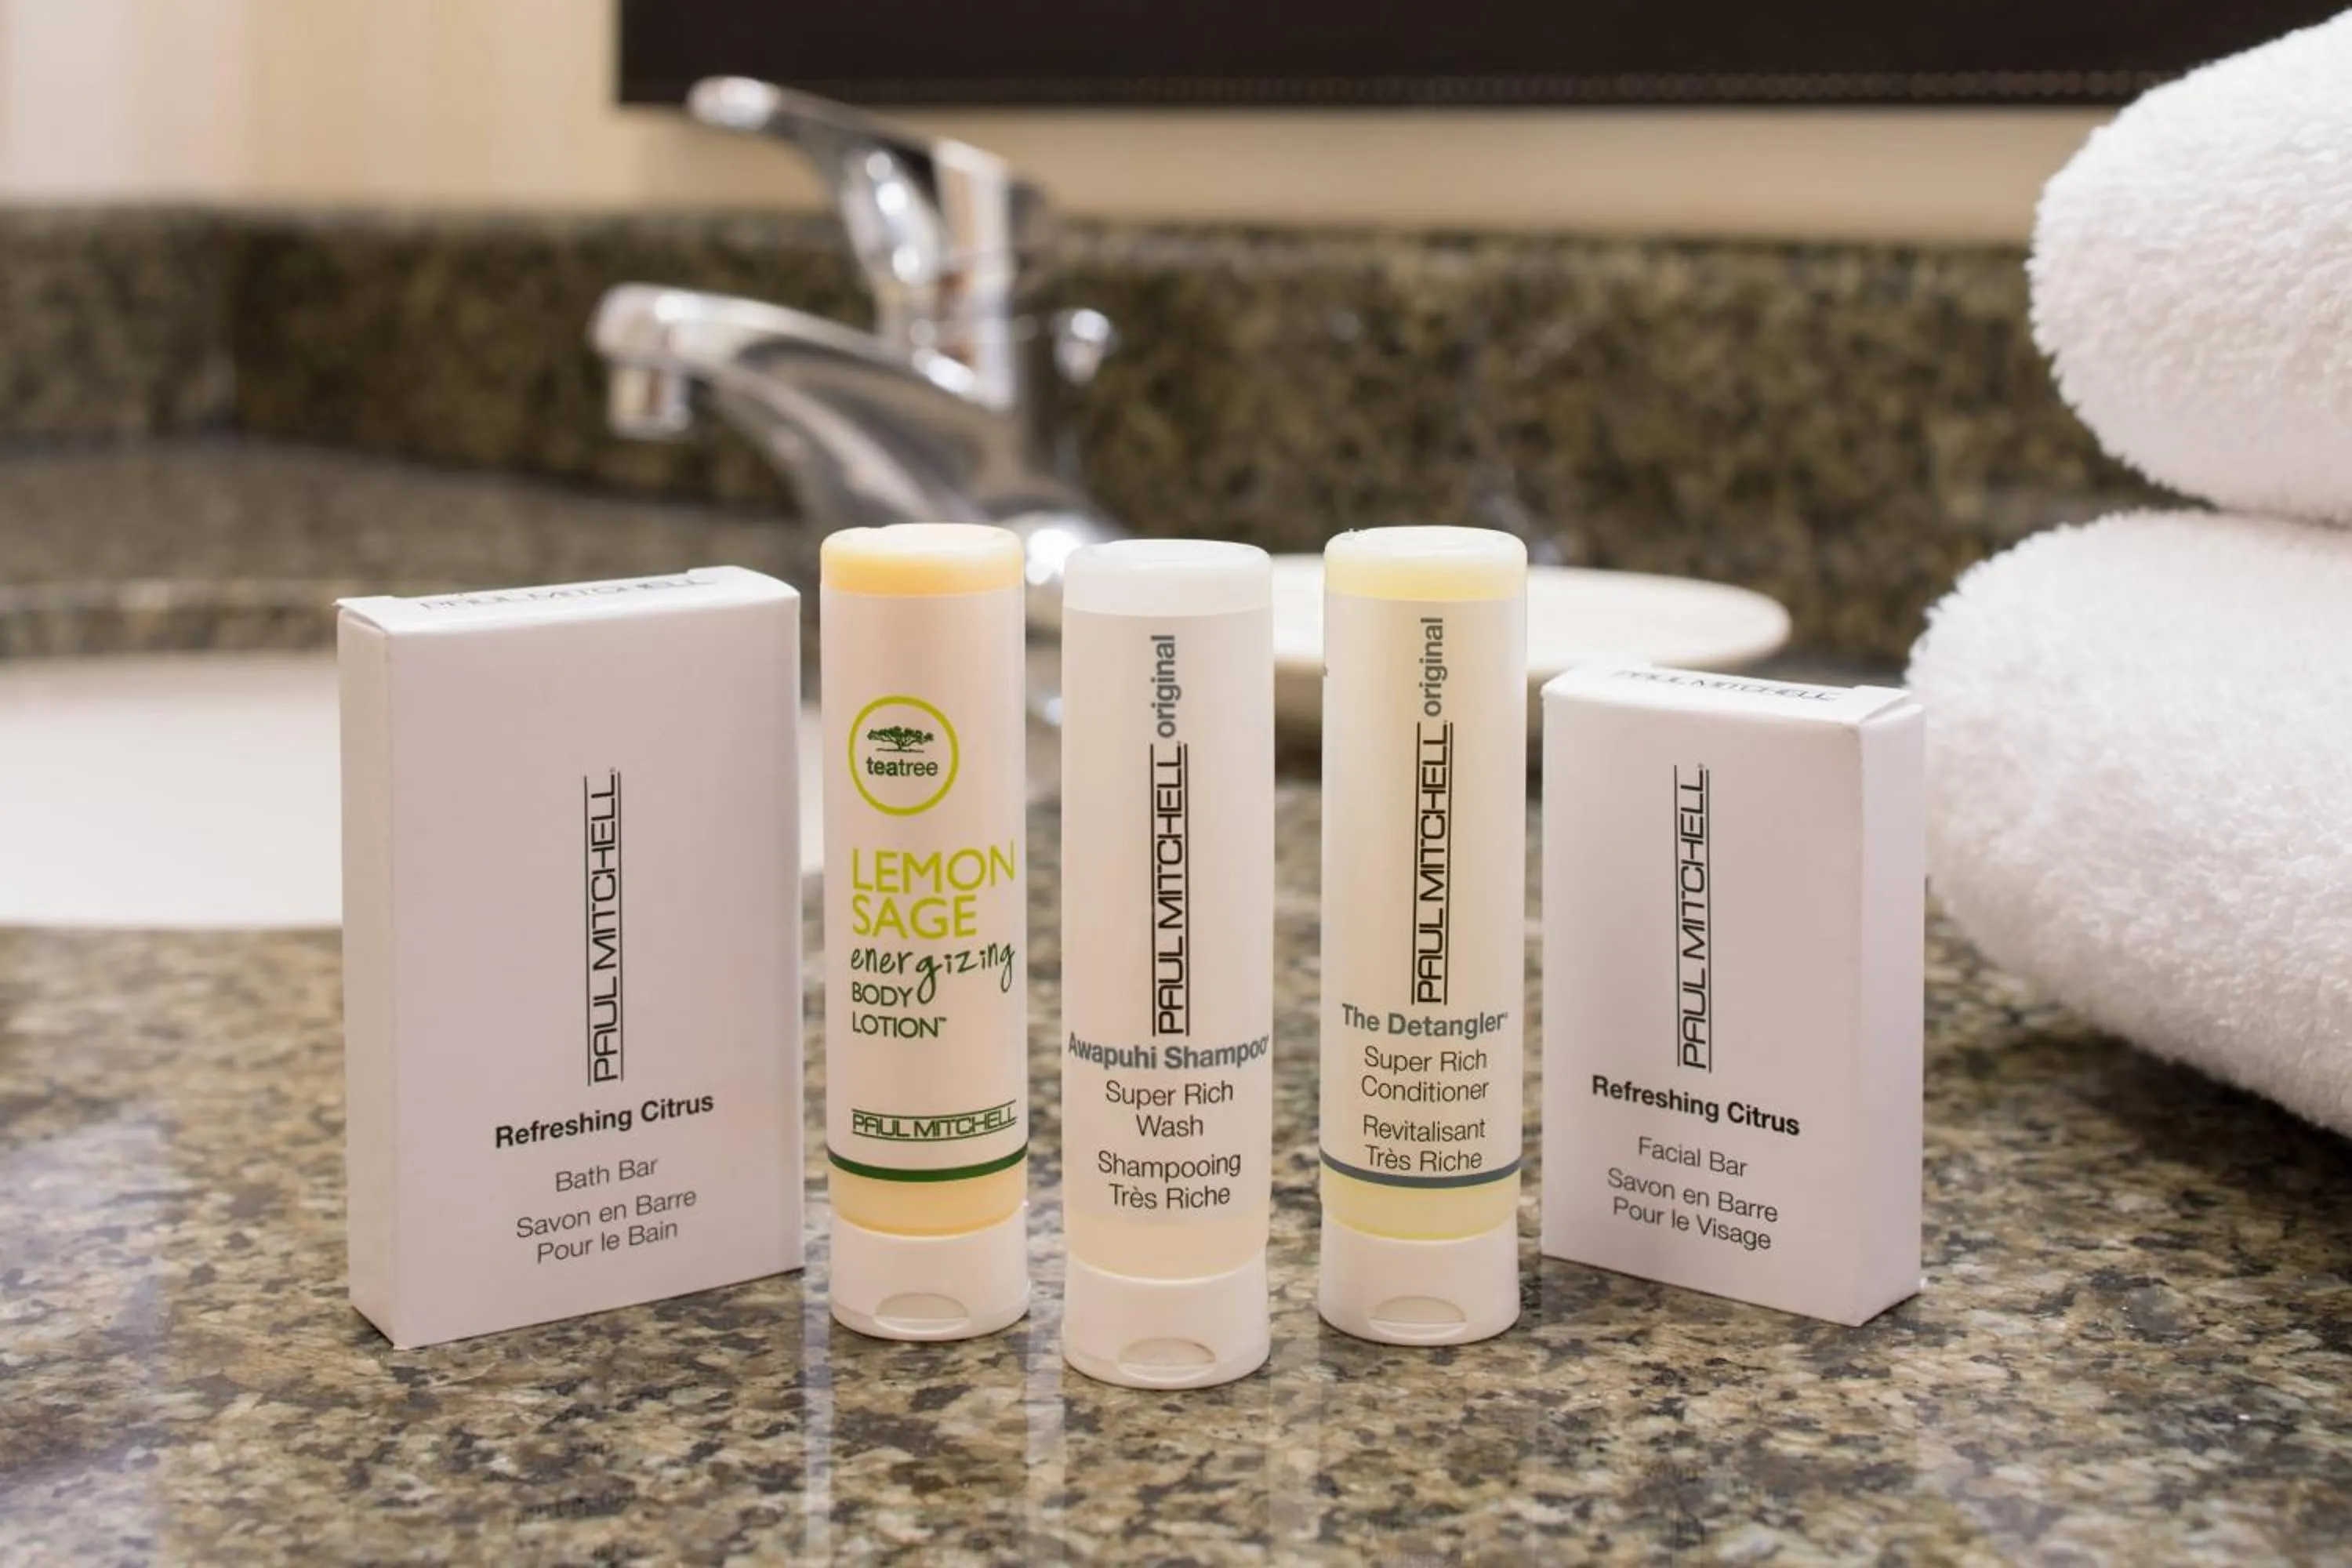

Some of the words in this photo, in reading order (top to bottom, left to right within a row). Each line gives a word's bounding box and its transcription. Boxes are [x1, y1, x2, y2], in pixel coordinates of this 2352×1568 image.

[1150, 635, 1182, 739] original
[1419, 618, 1447, 717] original
[866, 757, 938, 776] teatree
[1419, 724, 1447, 901] MITCHELL
[1156, 745, 1183, 930] MITCHELL
[590, 773, 617, 971] MITCHELL
[851, 840, 1014, 894] LEMON
[1680, 769, 1706, 960] MITCHELL
[851, 894, 977, 939] SAGE
[851, 942, 1015, 1004] energizing
[1417, 908, 1443, 1004] PAUL
[851, 981, 913, 1007] BODY
[1158, 936, 1184, 1035] PAUL
[593, 975, 619, 1083] PAUL
[1341, 1004, 1380, 1032] The
[1682, 967, 1707, 1069] PAUL
[1069, 1031, 1157, 1070] Awapuhi
[1164, 1035, 1267, 1069] Shampoo
[1364, 1045, 1432, 1075] Super
[1440, 1048, 1487, 1072] Rich
[1105, 1080, 1176, 1110] Super
[1185, 1080, 1233, 1105] Rich
[1361, 1075, 1490, 1102] Conditioner
[1592, 1074, 1719, 1123] Refreshing
[1727, 1102, 1800, 1136] Citrus
[495, 1109, 632, 1149] Refreshing
[641, 1094, 713, 1123] Citrus
[852, 1112, 909, 1137] PAUL
[913, 1107, 1017, 1138] MITCHELL
[1135, 1114, 1203, 1138] Wash
[1363, 1114, 1486, 1142] Revitalisant
[555, 1165, 609, 1192] Bath
[619, 1158, 659, 1181] Bar
[1098, 1150, 1241, 1183] Shampooing
[1364, 1145, 1411, 1171] Très
[1420, 1149, 1483, 1172] Riche
[1639, 1136, 1701, 1167] Facial
[1709, 1150, 1748, 1177] Bar
[516, 1210, 590, 1238] Savon
[599, 1203, 626, 1222] en
[636, 1190, 697, 1216] Barre
[1109, 1183, 1157, 1209] Très
[1166, 1185, 1230, 1209] Riche
[1607, 1167, 1675, 1200] Savon
[1682, 1188, 1710, 1207] en
[1718, 1191, 1778, 1223] Barre
[537, 1239, 593, 1264] Pour
[601, 1232, 619, 1251] le
[628, 1221, 678, 1246] Bain
[1613, 1196, 1665, 1225] Pour
[1671, 1209, 1690, 1231] le
[1696, 1214, 1772, 1252] Visage
